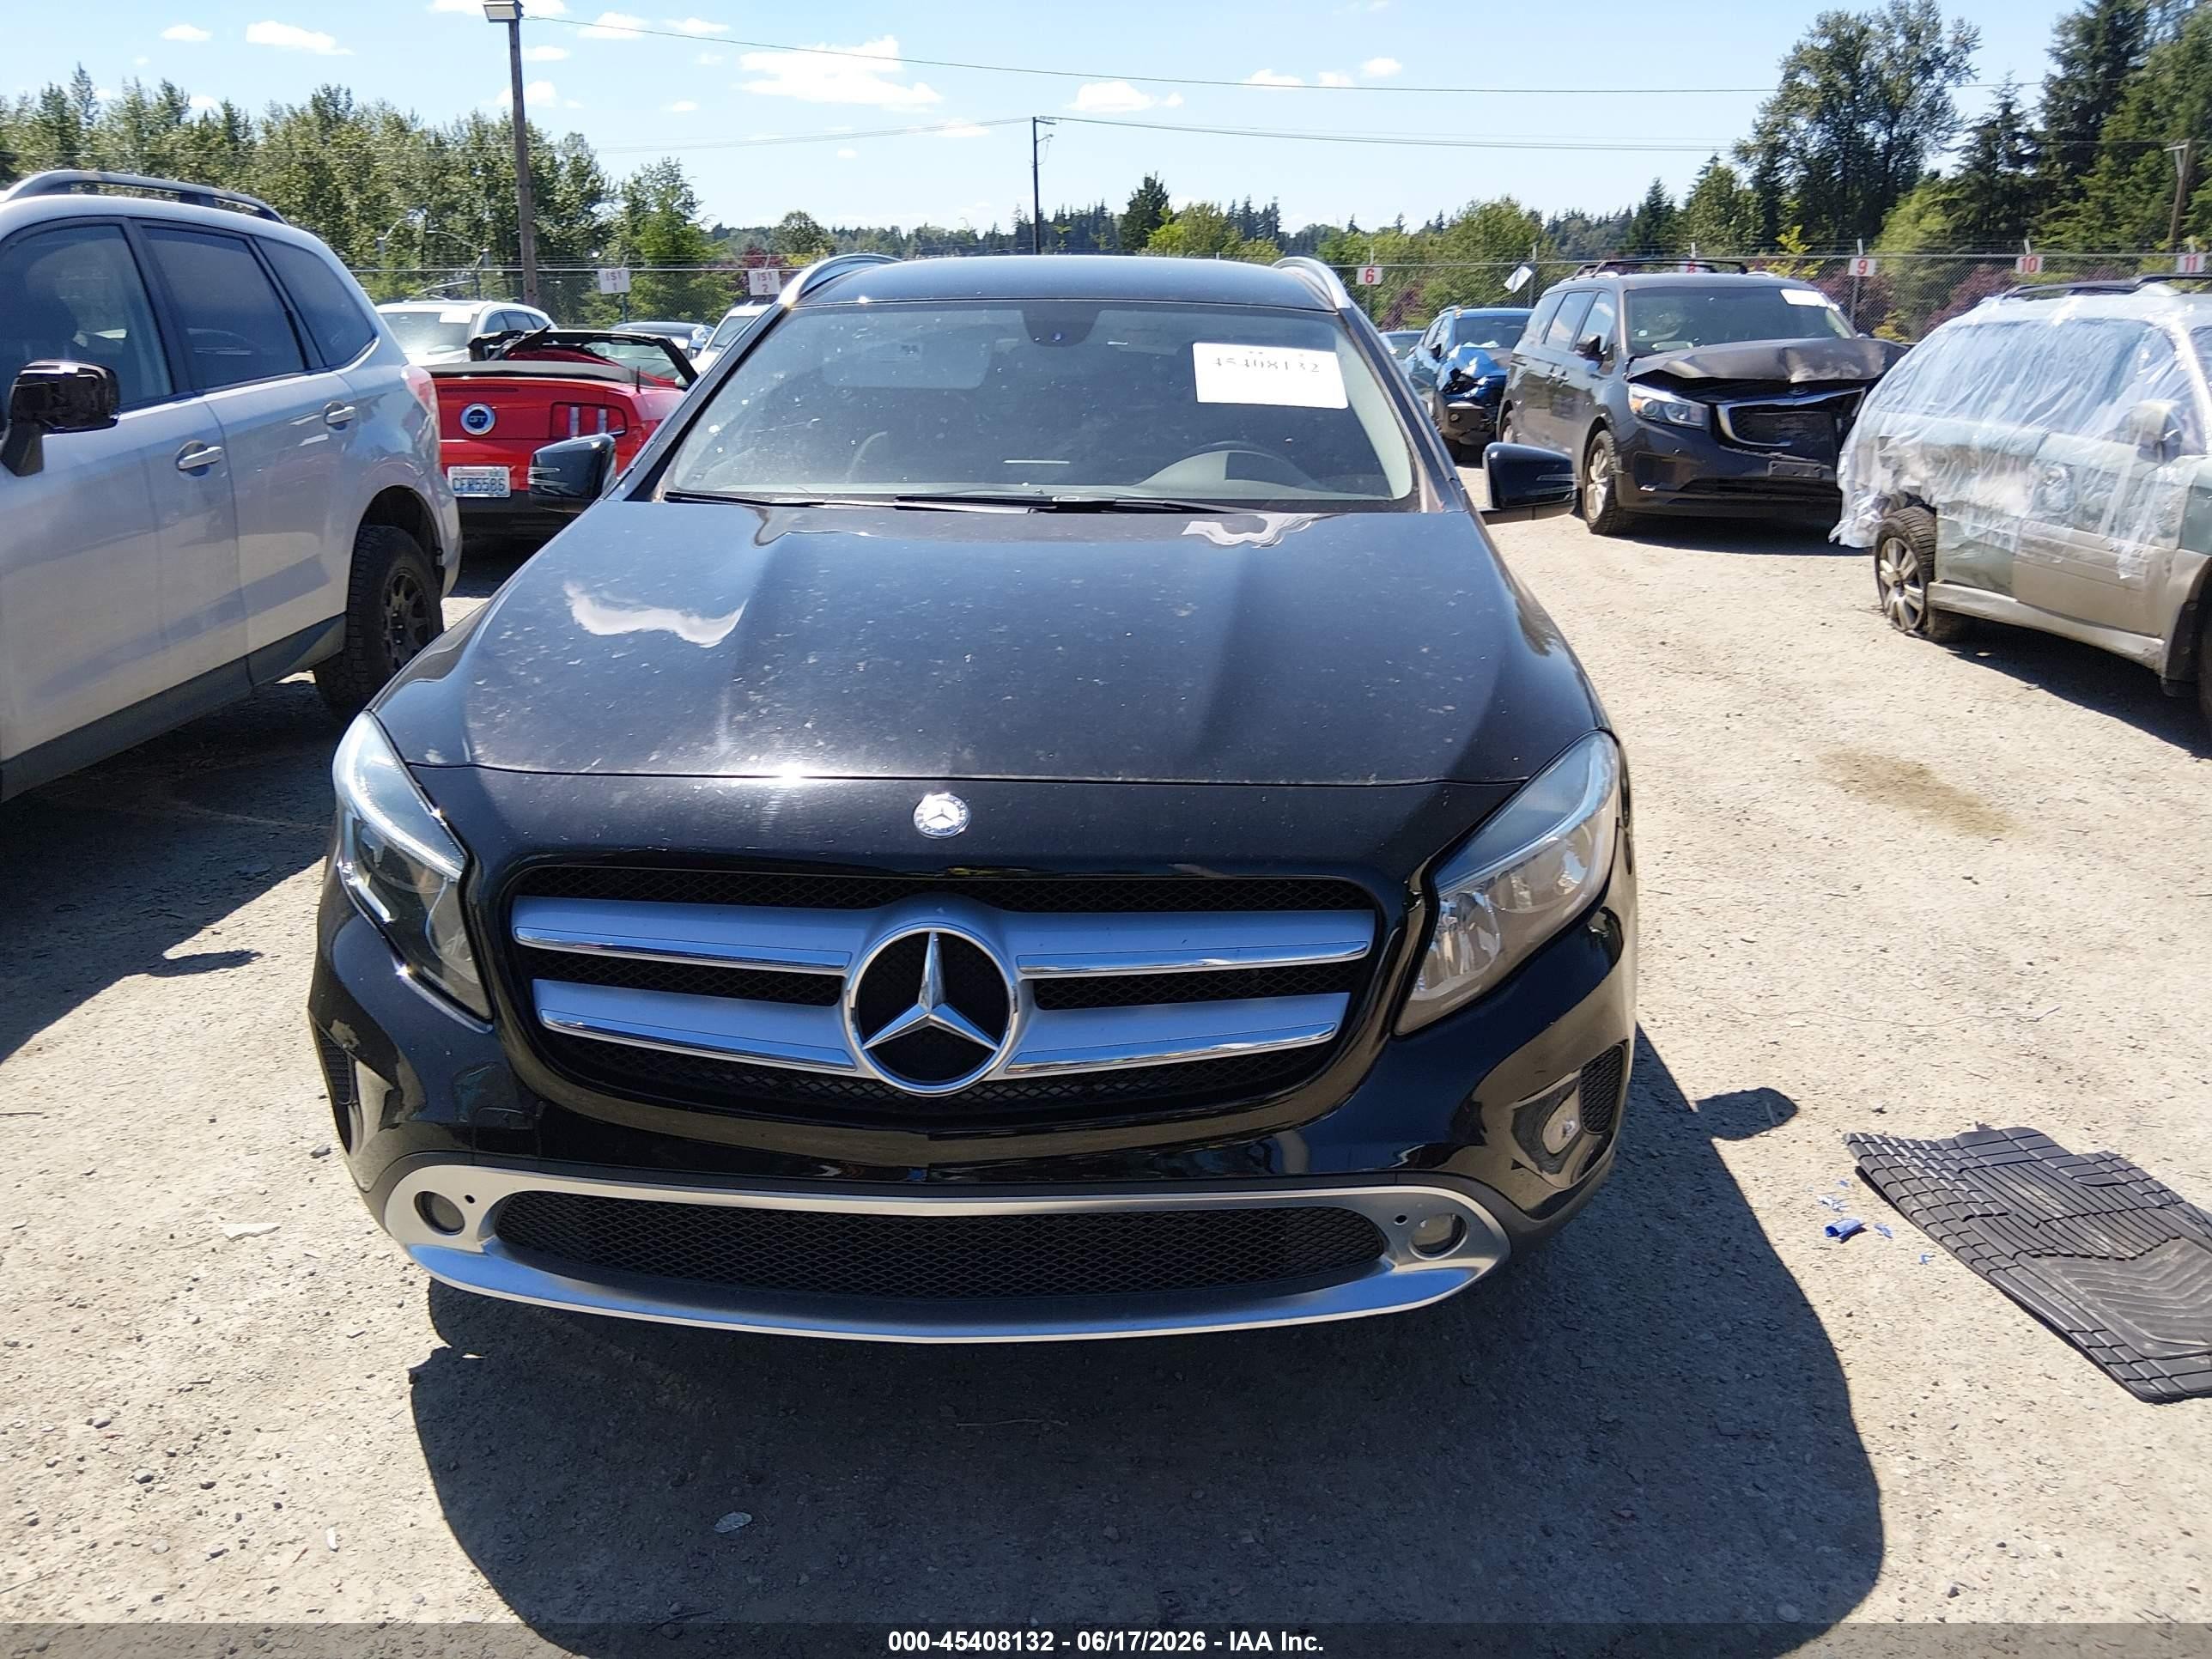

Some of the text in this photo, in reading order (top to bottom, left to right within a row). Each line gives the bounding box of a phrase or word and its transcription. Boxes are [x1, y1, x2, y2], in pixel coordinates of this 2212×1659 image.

[1857, 259, 1868, 275] 9
[2021, 258, 2039, 273] 10
[2185, 256, 2197, 272] 11
[1365, 268, 1374, 283] 6
[762, 283, 769, 294] 2
[468, 415, 487, 423] GT
